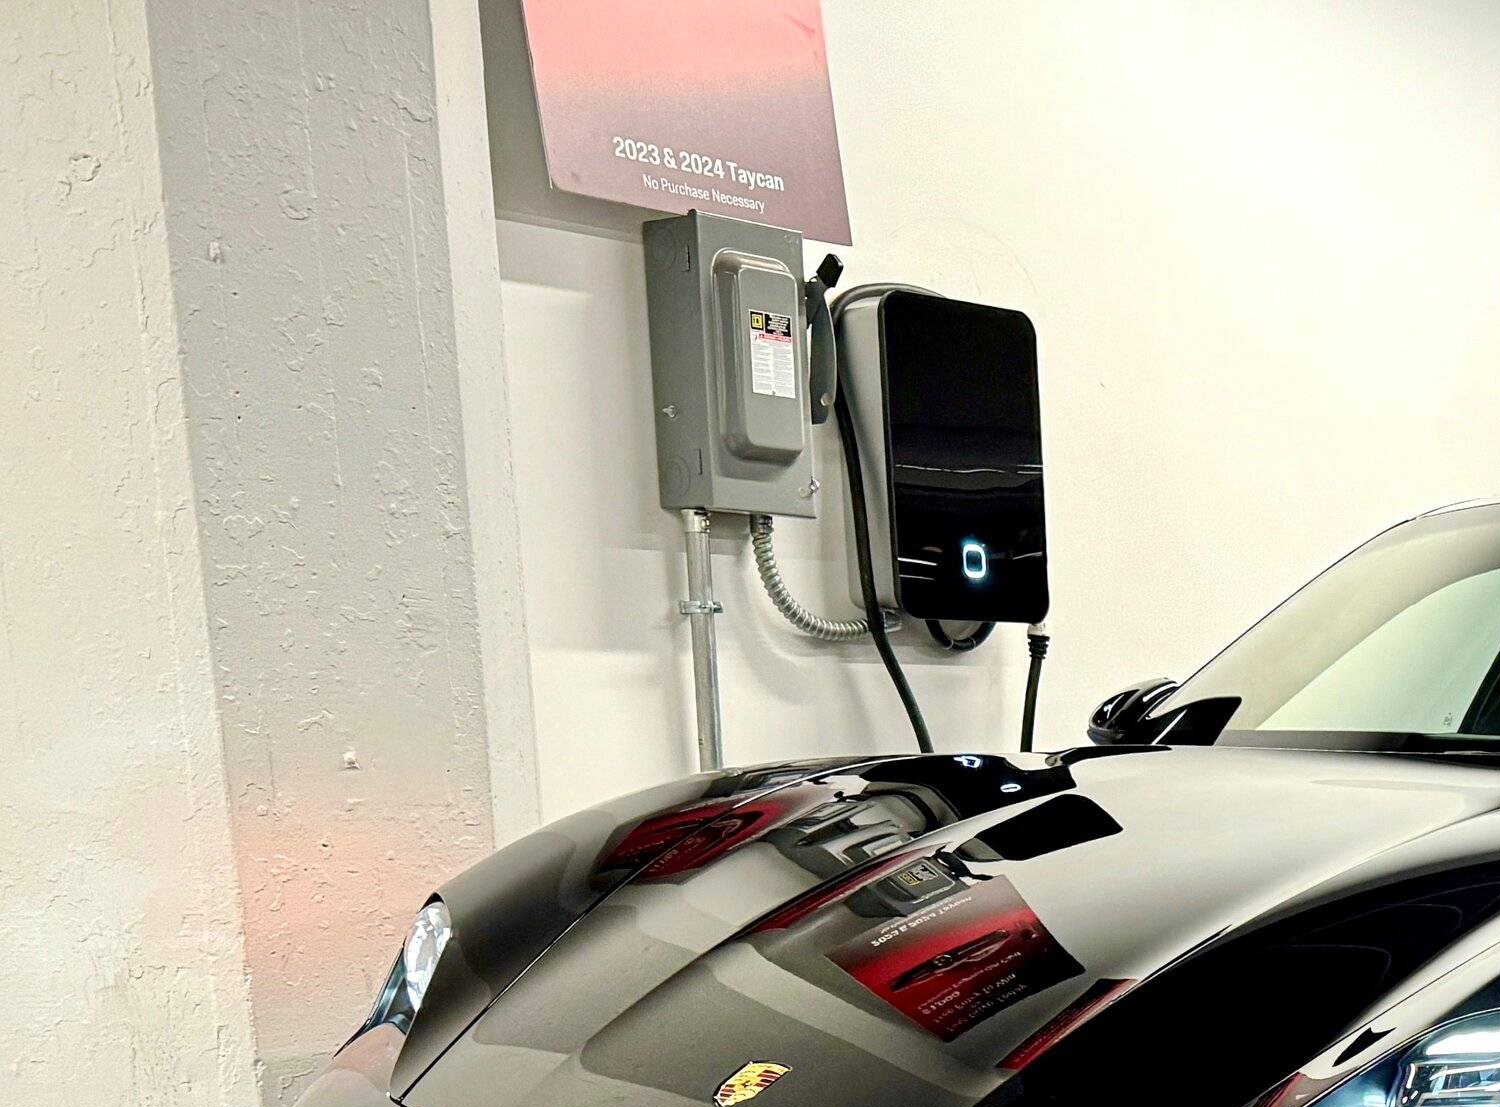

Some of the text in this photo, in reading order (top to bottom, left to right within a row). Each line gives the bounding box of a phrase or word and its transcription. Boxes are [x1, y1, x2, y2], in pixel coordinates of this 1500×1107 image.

[612, 136, 785, 192] 2023 & 2024 Taycan
[642, 173, 765, 214] No Purchase Necessary
